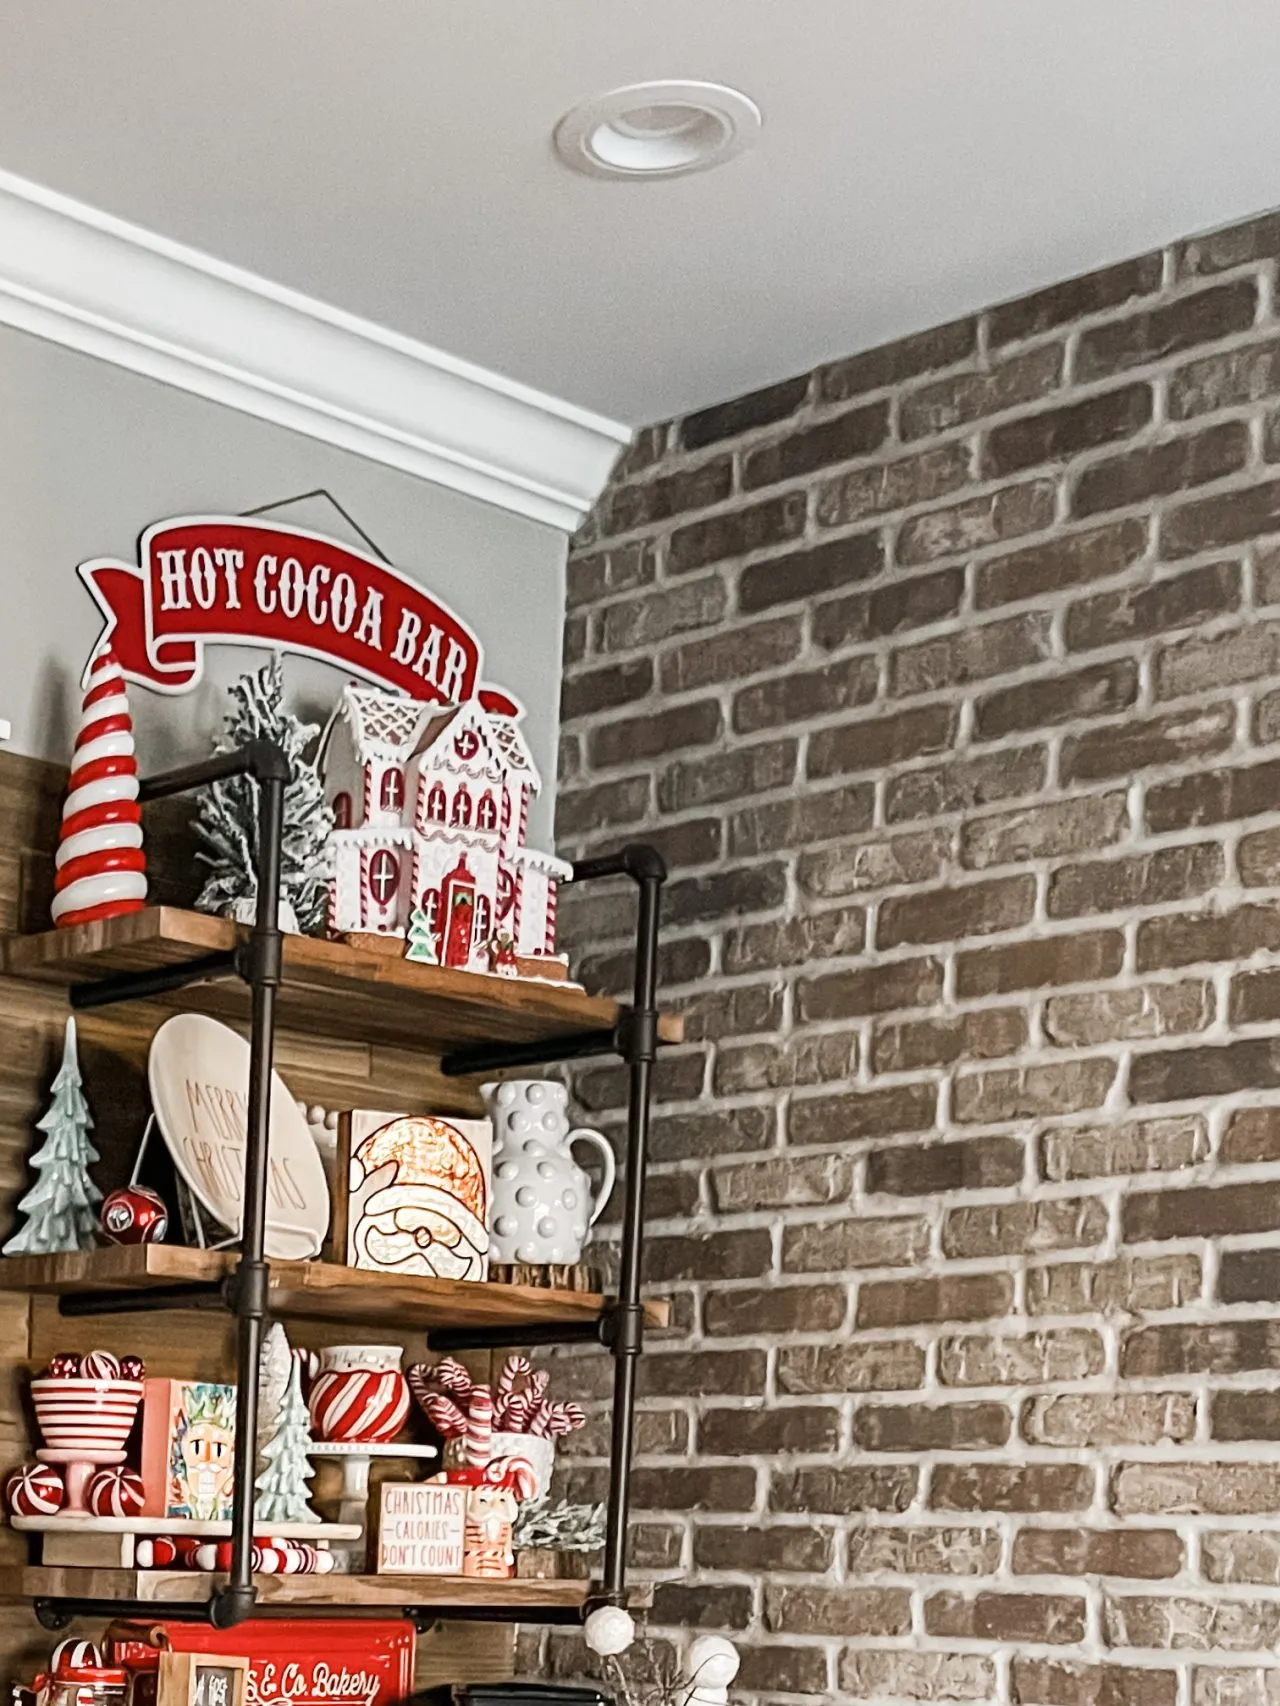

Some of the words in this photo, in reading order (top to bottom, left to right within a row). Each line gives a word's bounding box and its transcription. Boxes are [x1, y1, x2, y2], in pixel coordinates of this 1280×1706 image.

[156, 547, 244, 612] HOT
[253, 554, 384, 652] COCOA
[389, 607, 468, 704] BAR
[183, 1136, 307, 1210] CHRISTAS
[384, 1490, 461, 1516] CHRISTMAS
[381, 1544, 417, 1567] DON'T
[420, 1545, 461, 1568] COUNT
[281, 1663, 308, 1698] Co.
